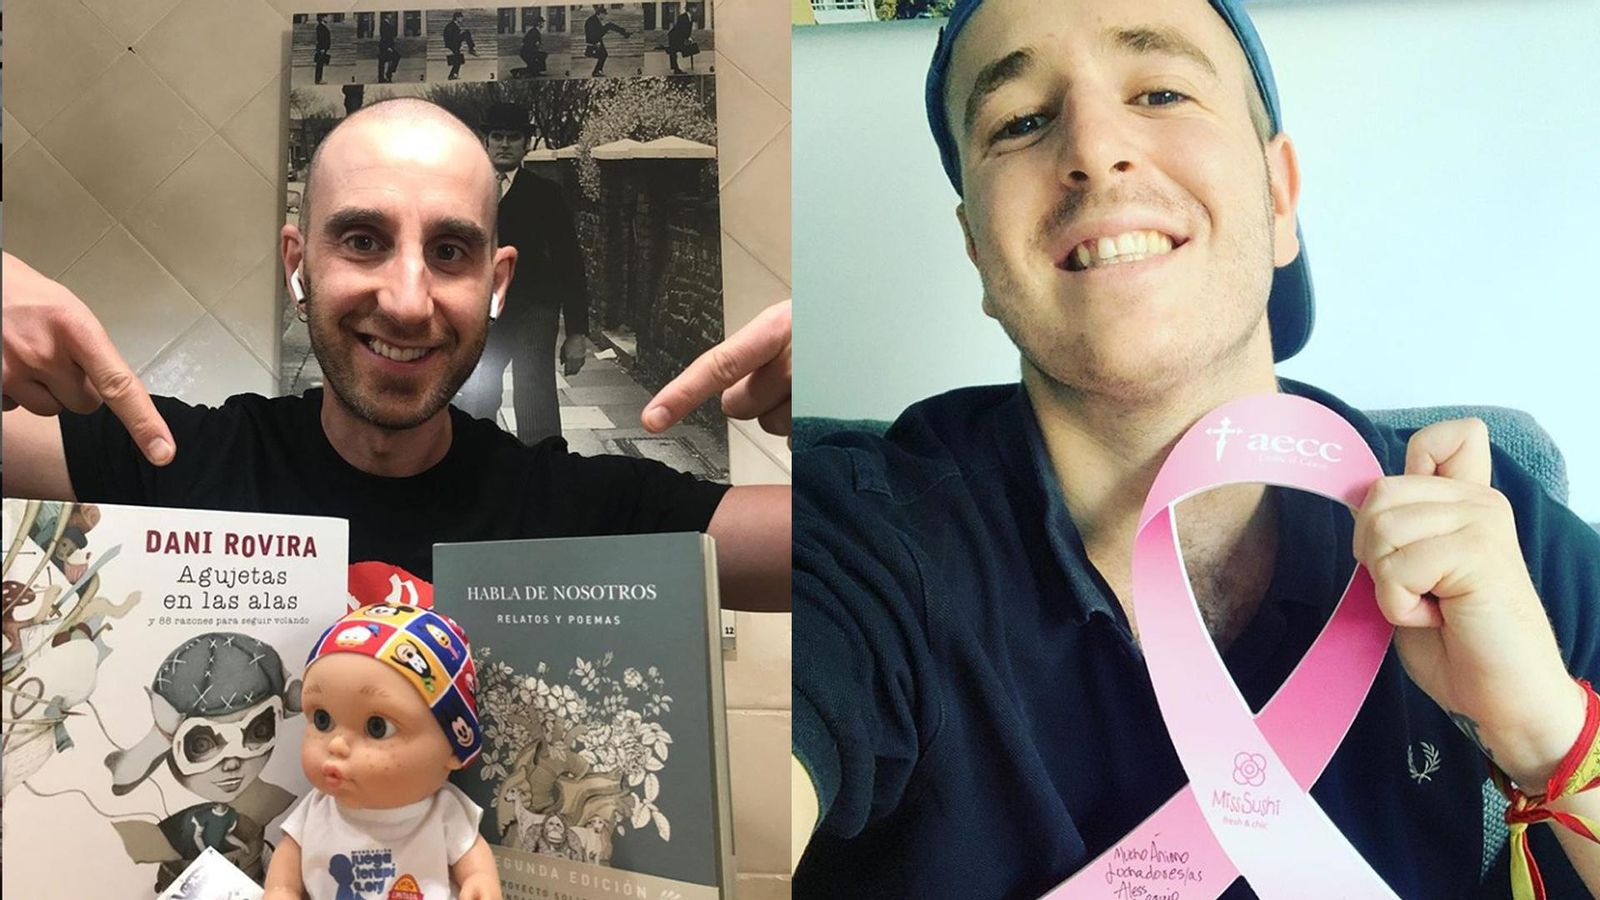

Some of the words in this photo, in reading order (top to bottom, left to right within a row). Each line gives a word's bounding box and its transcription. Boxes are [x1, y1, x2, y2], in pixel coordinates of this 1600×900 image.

[1247, 432, 1343, 462] aecc
[145, 530, 213, 555] DANI
[224, 532, 318, 558] ROVIRA
[176, 565, 288, 588] Agujetas
[163, 594, 193, 610] en
[201, 591, 240, 610] las
[248, 592, 299, 610] alas
[467, 585, 521, 600] HABLA
[525, 585, 549, 600] DE
[553, 584, 657, 600] NOSOTROS
[147, 617, 155, 626] y
[158, 617, 172, 625] 88
[174, 618, 214, 626] razones
[216, 618, 239, 626] para
[241, 617, 272, 626] seguir
[273, 616, 310, 626] volando
[497, 614, 550, 624] RELATOS
[555, 615, 562, 624] Y
[568, 615, 621, 625] POEMAS
[725, 626, 735, 635] 12
[496, 856, 560, 881] EGUNDA
[569, 871, 648, 899] EDICIÓN
[501, 880, 549, 898] ROYECTO
